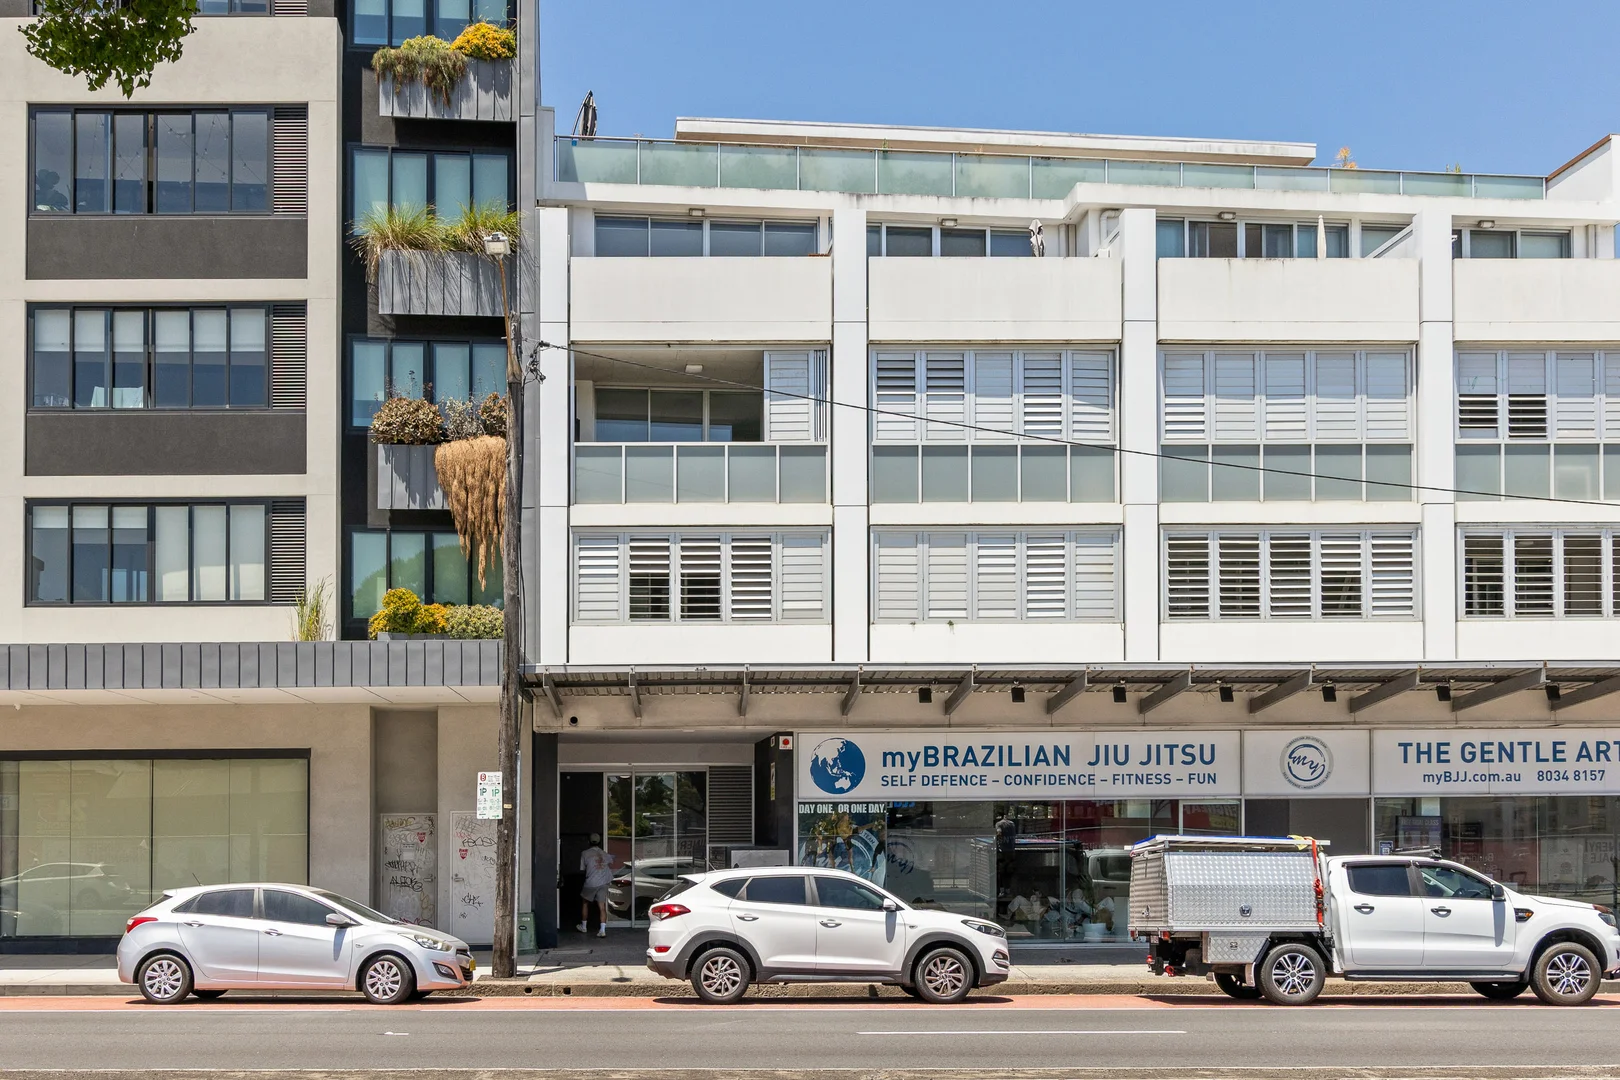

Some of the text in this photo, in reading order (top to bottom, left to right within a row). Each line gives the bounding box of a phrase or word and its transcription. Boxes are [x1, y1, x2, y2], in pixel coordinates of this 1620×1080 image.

[882, 743, 1215, 772] myBRAZILIAN JIU JITSU
[1397, 742, 1451, 763] THE
[1461, 741, 1567, 763] GENTLE
[881, 775, 916, 787] SELF
[921, 775, 988, 786] DEFENCE
[1004, 774, 1096, 786] CONFIDENCE
[1112, 773, 1172, 785] FITNESS
[1188, 773, 1217, 785] FUN
[1423, 770, 1605, 785] myBJJ.com.au 8034 8157
[799, 804, 815, 814] DAY
[838, 803, 850, 814] OR
[850, 803, 867, 814] ONE
[868, 803, 887, 814] DAY.
